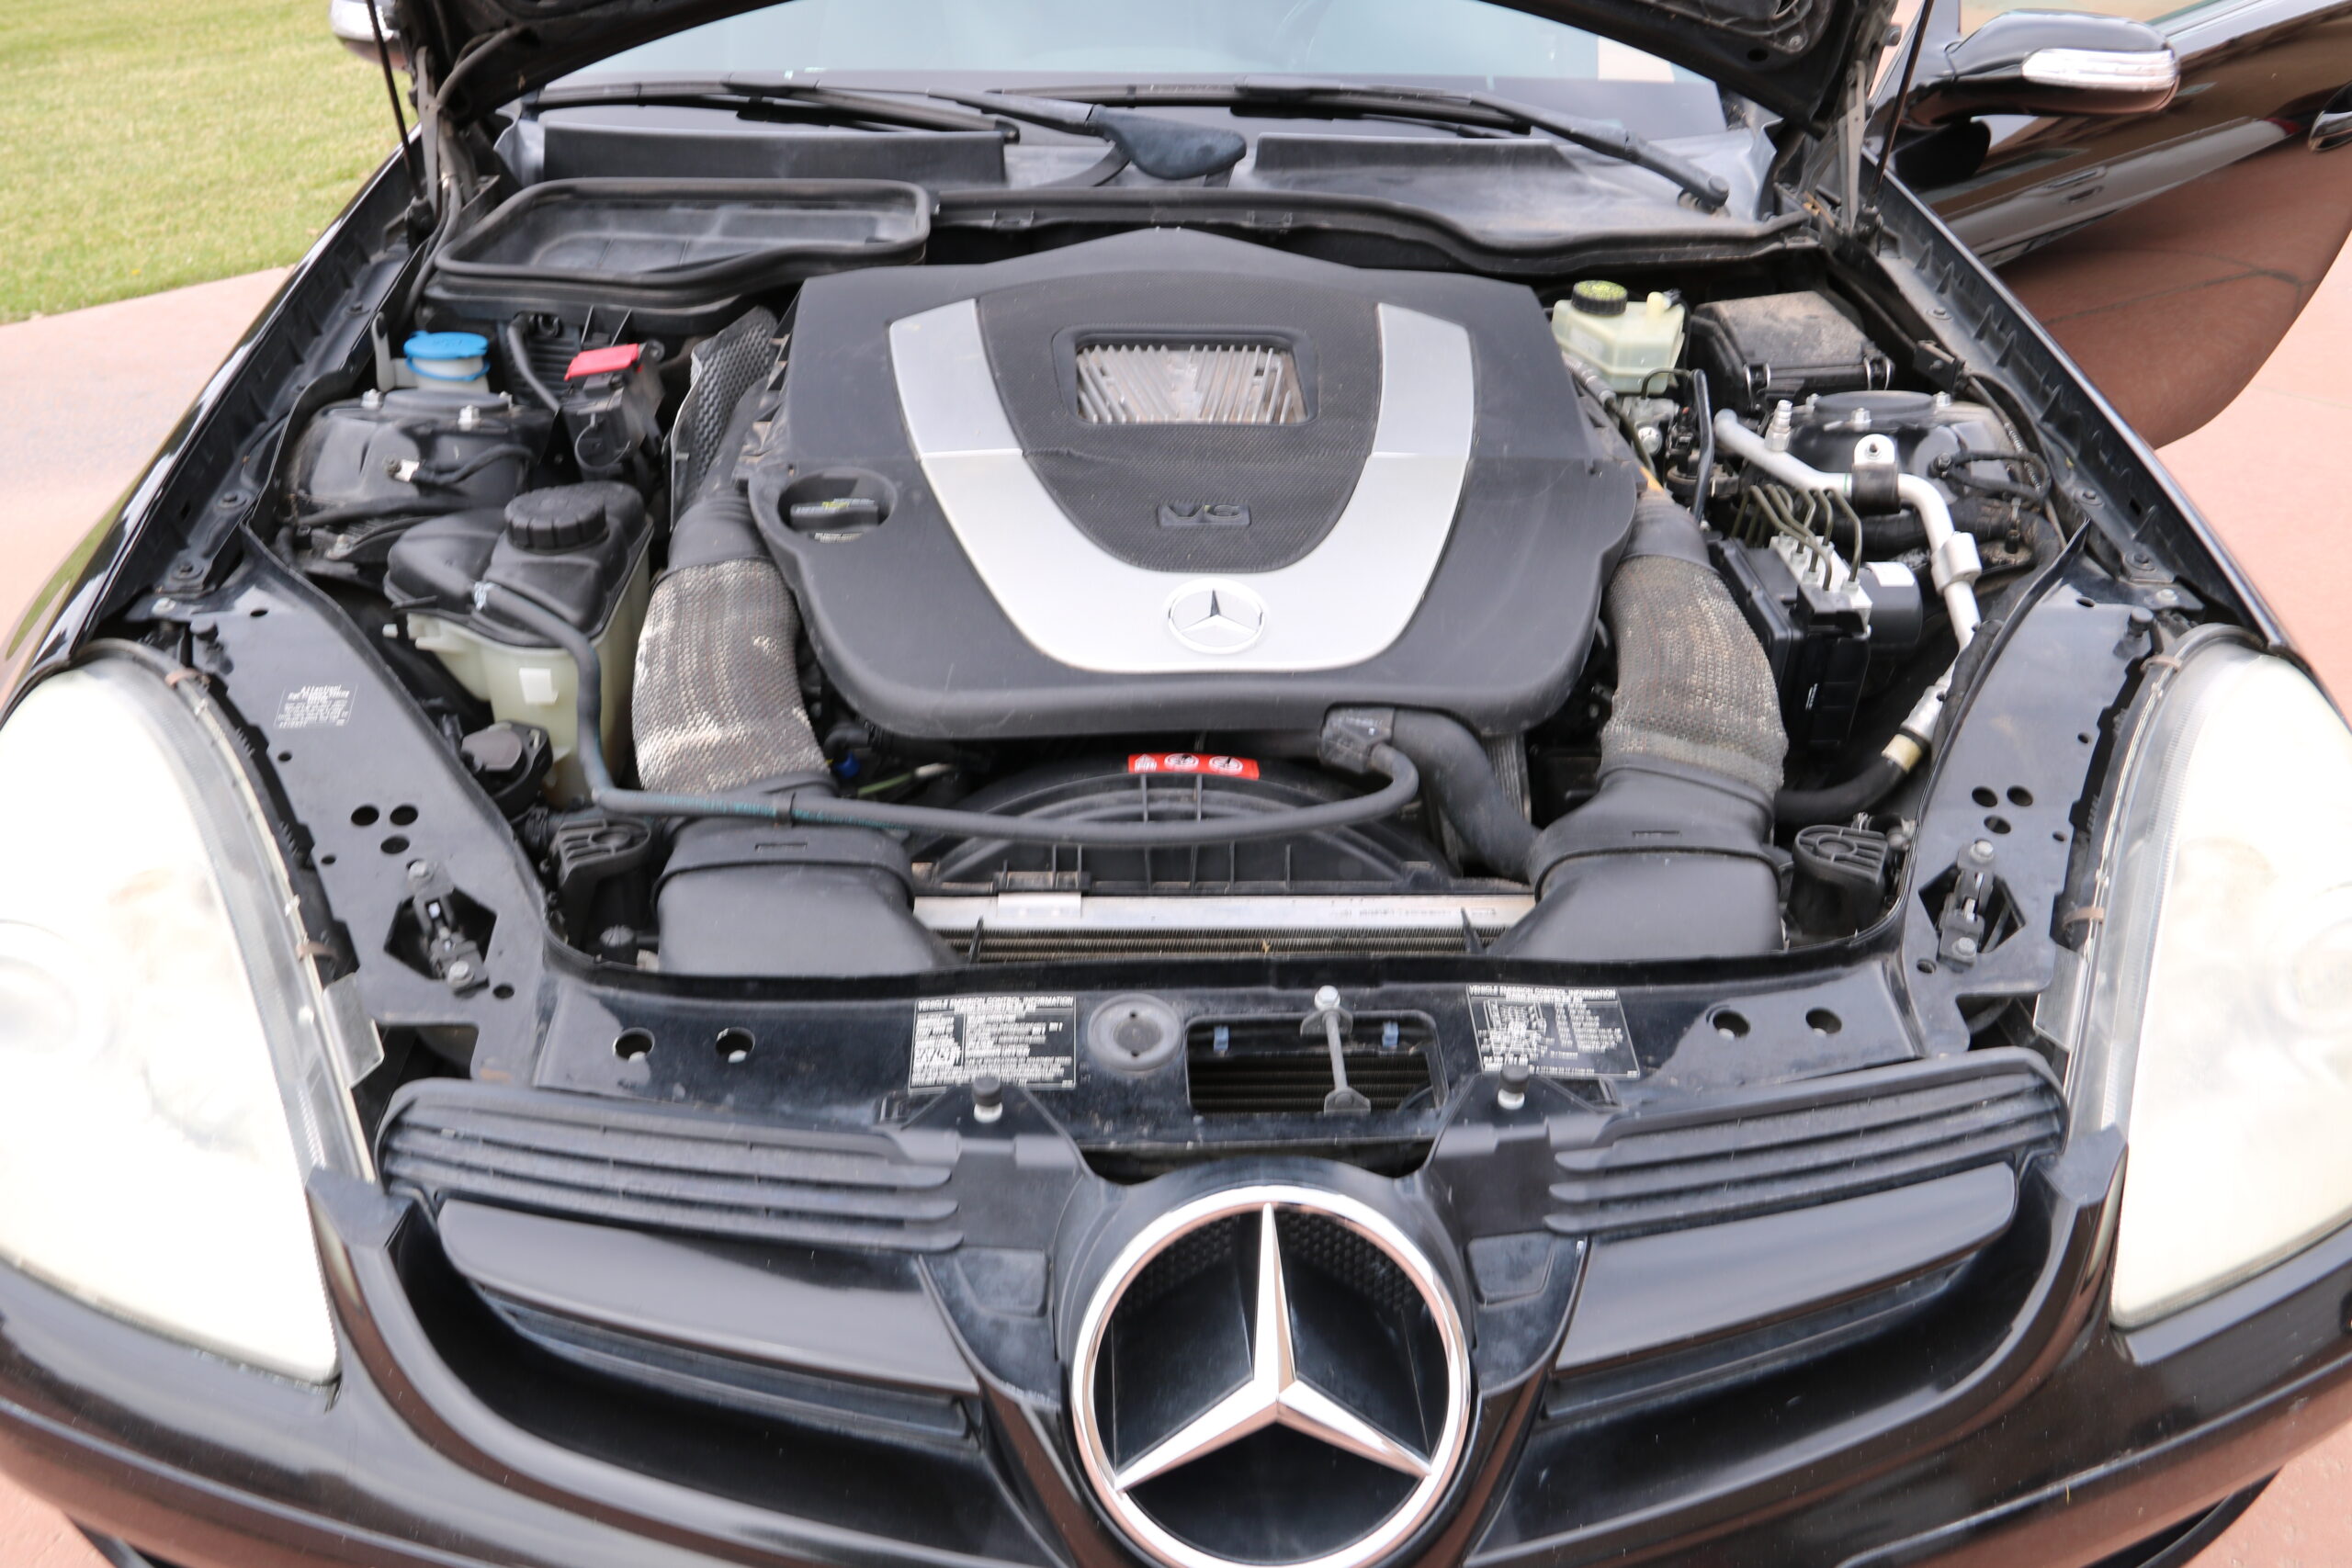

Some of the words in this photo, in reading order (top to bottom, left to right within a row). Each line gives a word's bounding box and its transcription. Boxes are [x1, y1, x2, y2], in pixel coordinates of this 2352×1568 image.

[1469, 985, 1498, 996] VEHICLE
[1499, 986, 1533, 997] EMISSION
[1534, 987, 1566, 998] CONTROL
[1568, 988, 1617, 1000] INFORMATION
[918, 998, 948, 1011] VEHICLE
[949, 997, 986, 1009] EMISSION
[986, 996, 1023, 1008] CONTROL
[1023, 996, 1074, 1008] INFORMATION
